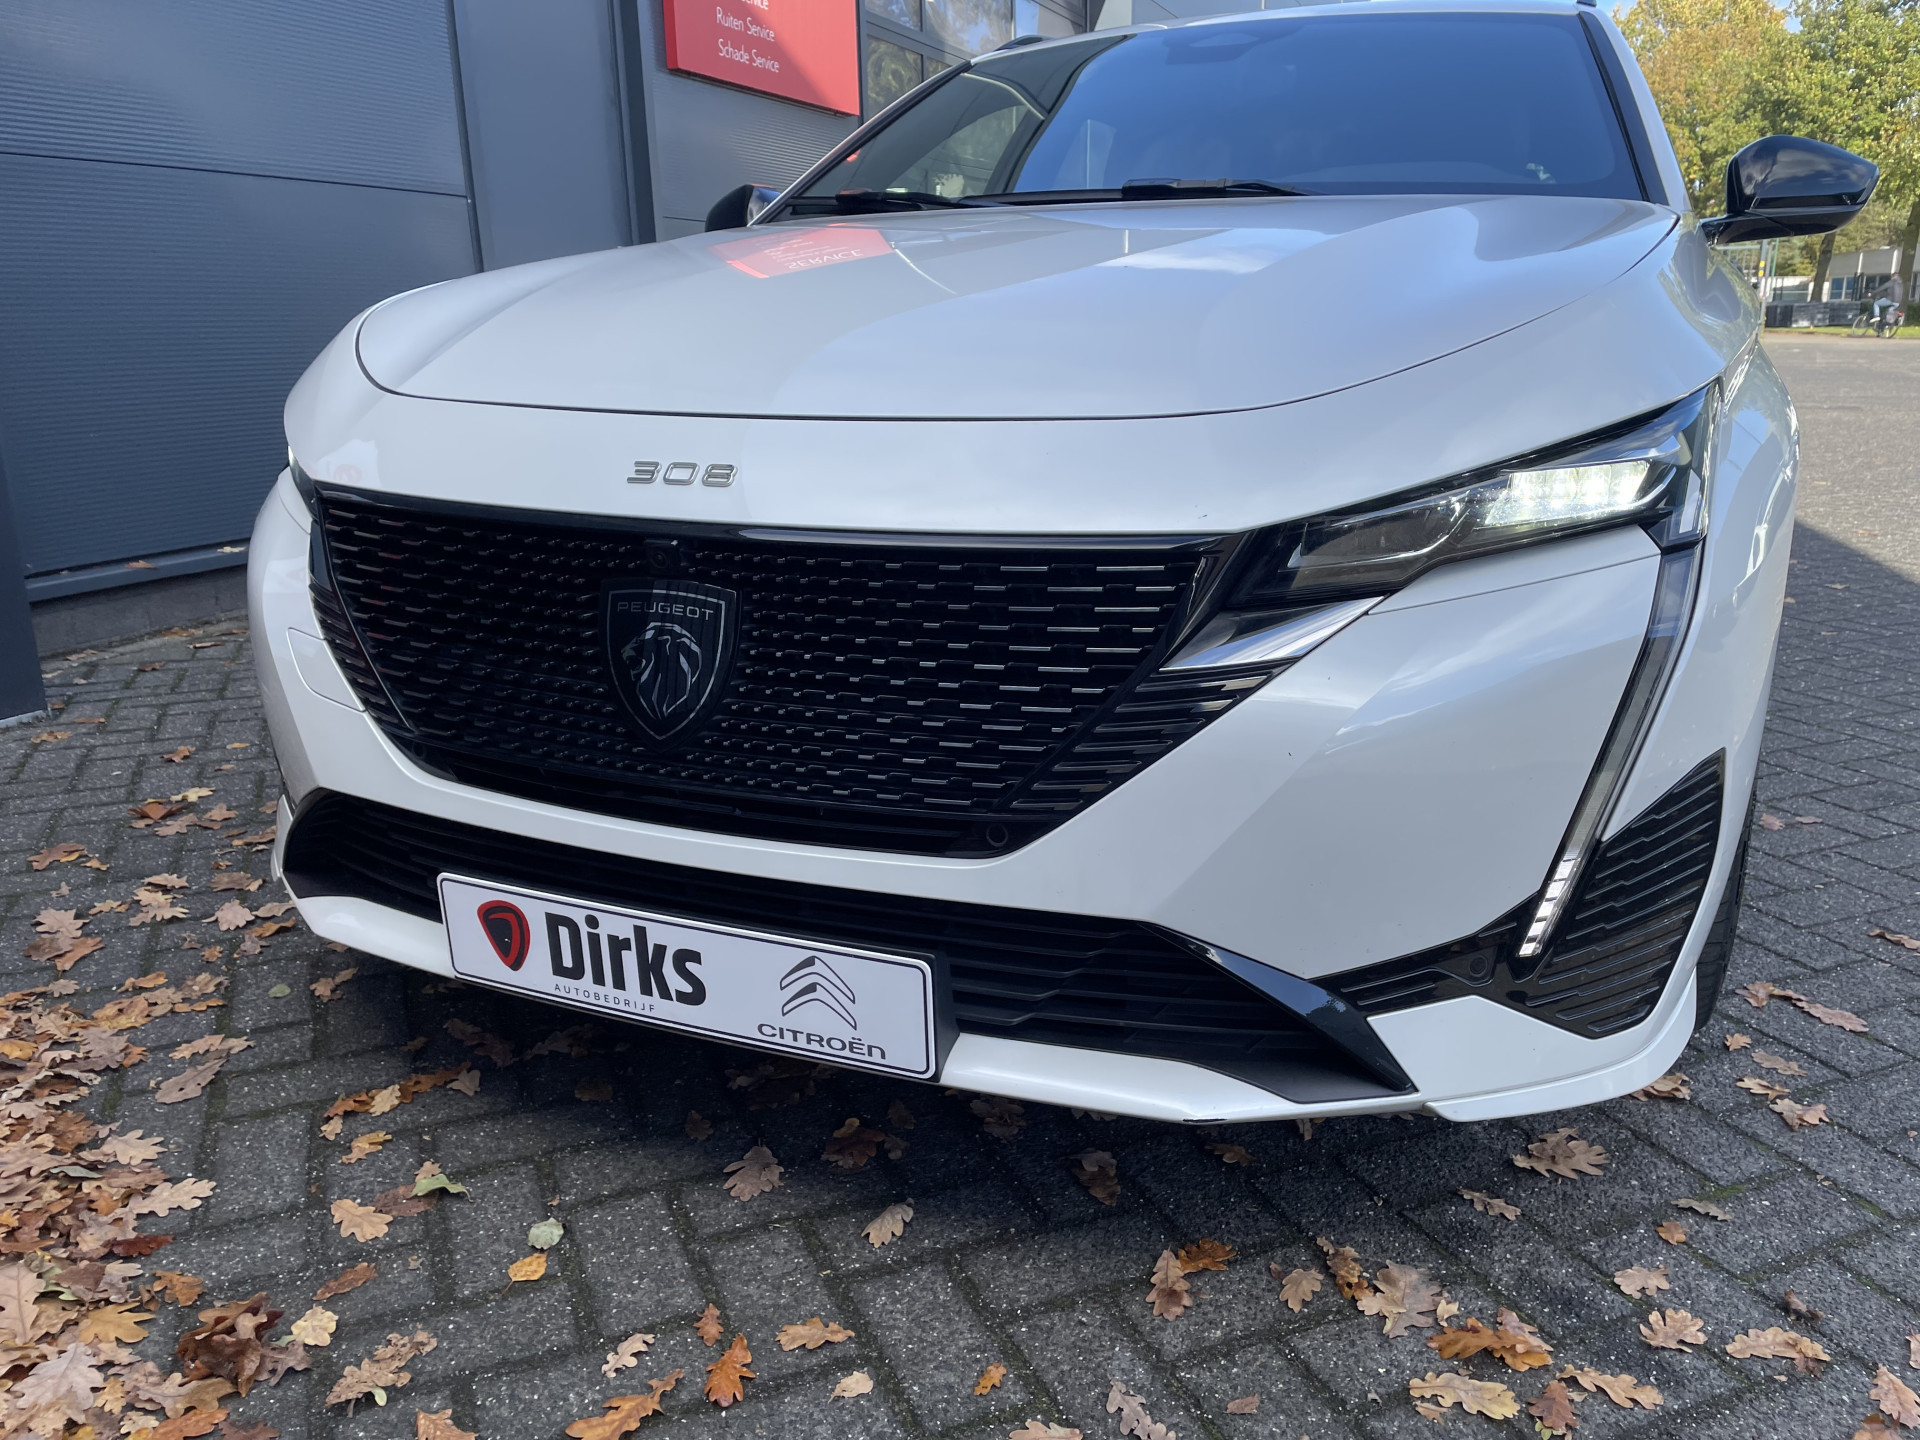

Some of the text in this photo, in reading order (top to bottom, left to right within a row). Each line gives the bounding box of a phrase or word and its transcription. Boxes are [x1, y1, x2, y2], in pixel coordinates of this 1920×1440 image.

[716, 6, 775, 41] Ruiten Service
[718, 38, 779, 73] Schade Service
[626, 460, 738, 488] 308
[617, 601, 714, 621] PEUGEOT
[545, 911, 707, 1006] Dirks
[554, 983, 656, 1013] AUTOBEDRIJF
